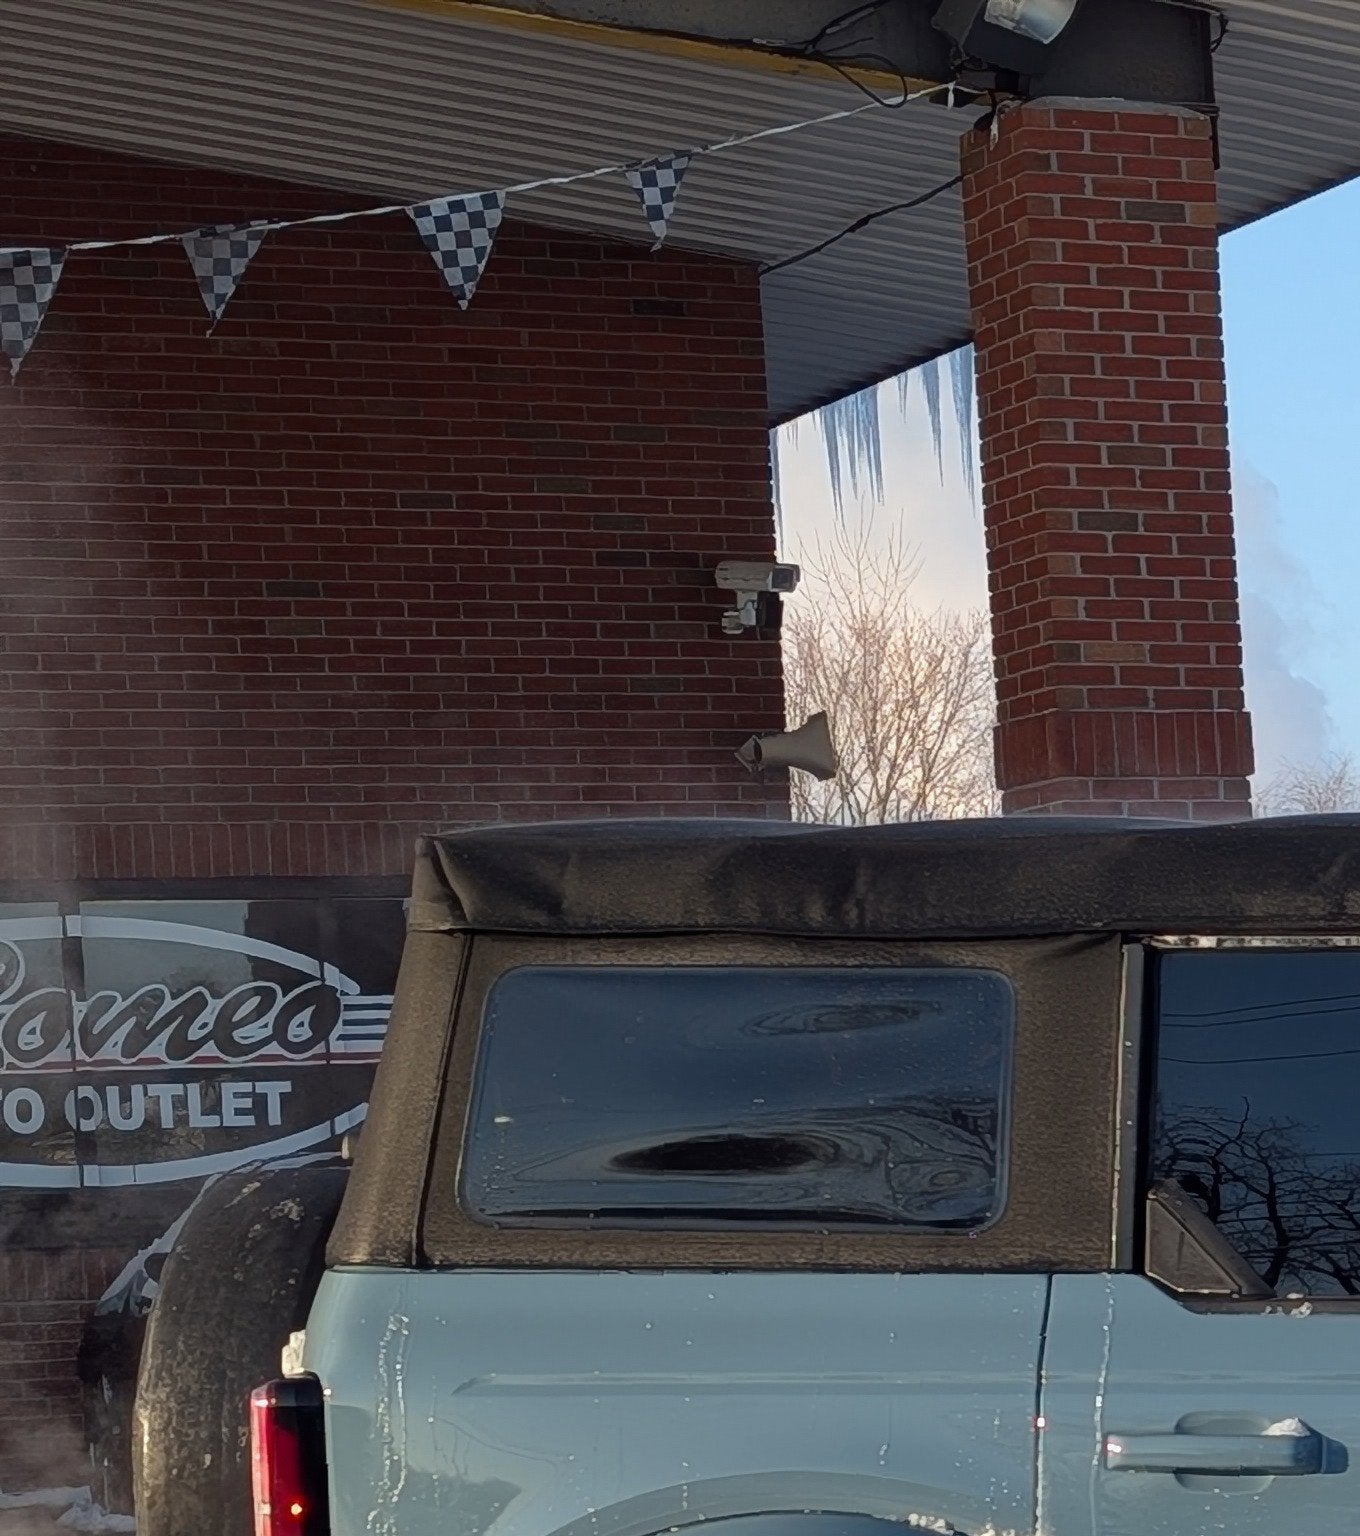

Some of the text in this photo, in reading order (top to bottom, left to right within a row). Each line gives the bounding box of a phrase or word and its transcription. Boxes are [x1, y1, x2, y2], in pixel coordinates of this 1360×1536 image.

[0, 939, 342, 1065] omeo
[0, 1080, 292, 1135] O OUTLET
